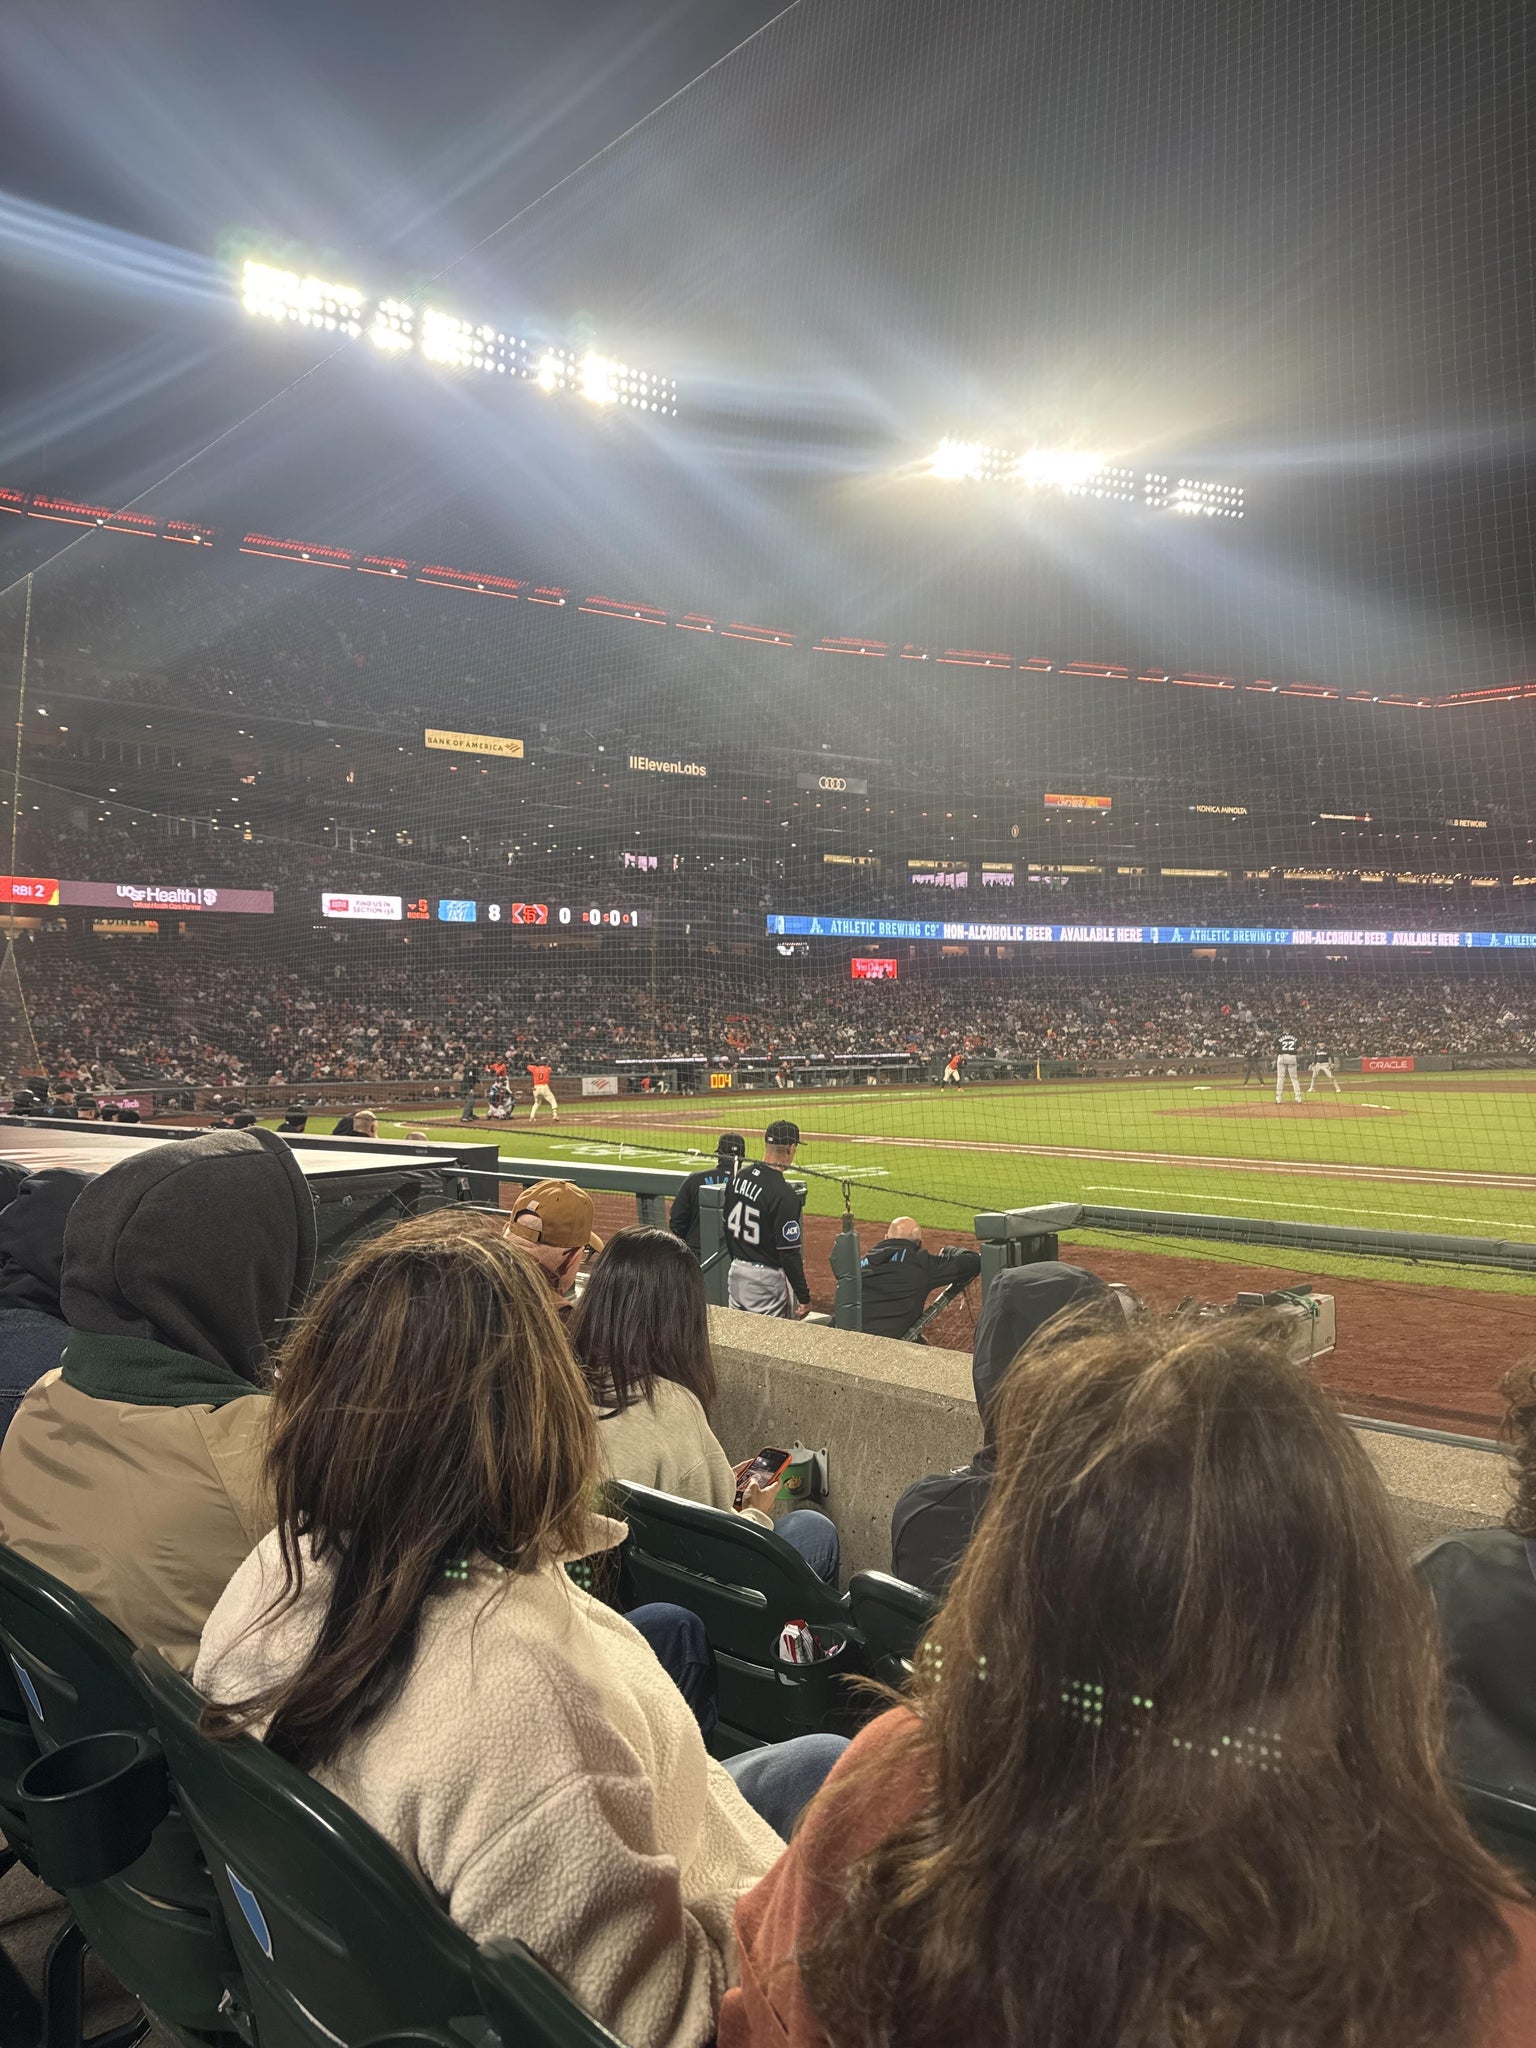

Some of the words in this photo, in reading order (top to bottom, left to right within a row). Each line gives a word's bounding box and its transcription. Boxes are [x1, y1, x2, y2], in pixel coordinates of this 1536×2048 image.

[427, 737, 450, 746] BANK
[465, 742, 503, 751] AMERICA
[1196, 805, 1220, 813] KONICA
[1221, 806, 1248, 815] MINOLTA
[1459, 819, 1488, 828] NETWORK
[12, 884, 32, 896] RBI
[34, 884, 45, 897] 2
[146, 887, 196, 903] Health
[418, 899, 428, 912] 5
[488, 904, 501, 921] 8
[559, 907, 571, 924] 0
[589, 909, 601, 926] 0
[609, 909, 621, 926] 0
[630, 910, 638, 927] 1
[830, 920, 876, 935] ATHLETIC
[879, 923, 921, 936] BREWING
[943, 923, 1024, 941] NON-ALCOHOLIC
[1025, 926, 1052, 942] BEER
[1059, 927, 1115, 942] AVAILABLE
[1117, 928, 1143, 942] HERE
[1189, 930, 1231, 942] ATHLETIC
[1233, 930, 1271, 942] BREWING
[1292, 930, 1364, 945] NON-ALCOHOLIC
[1364, 932, 1387, 945] BEER
[1392, 932, 1437, 946] AVAILABLE
[1437, 933, 1460, 946] HERE
[1282, 1041, 1295, 1051] 22
[1369, 1060, 1408, 1070] ORACLE
[734, 1178, 763, 1202] LALLI
[727, 1201, 760, 1245] 45
[785, 1226, 798, 1236] ADT
